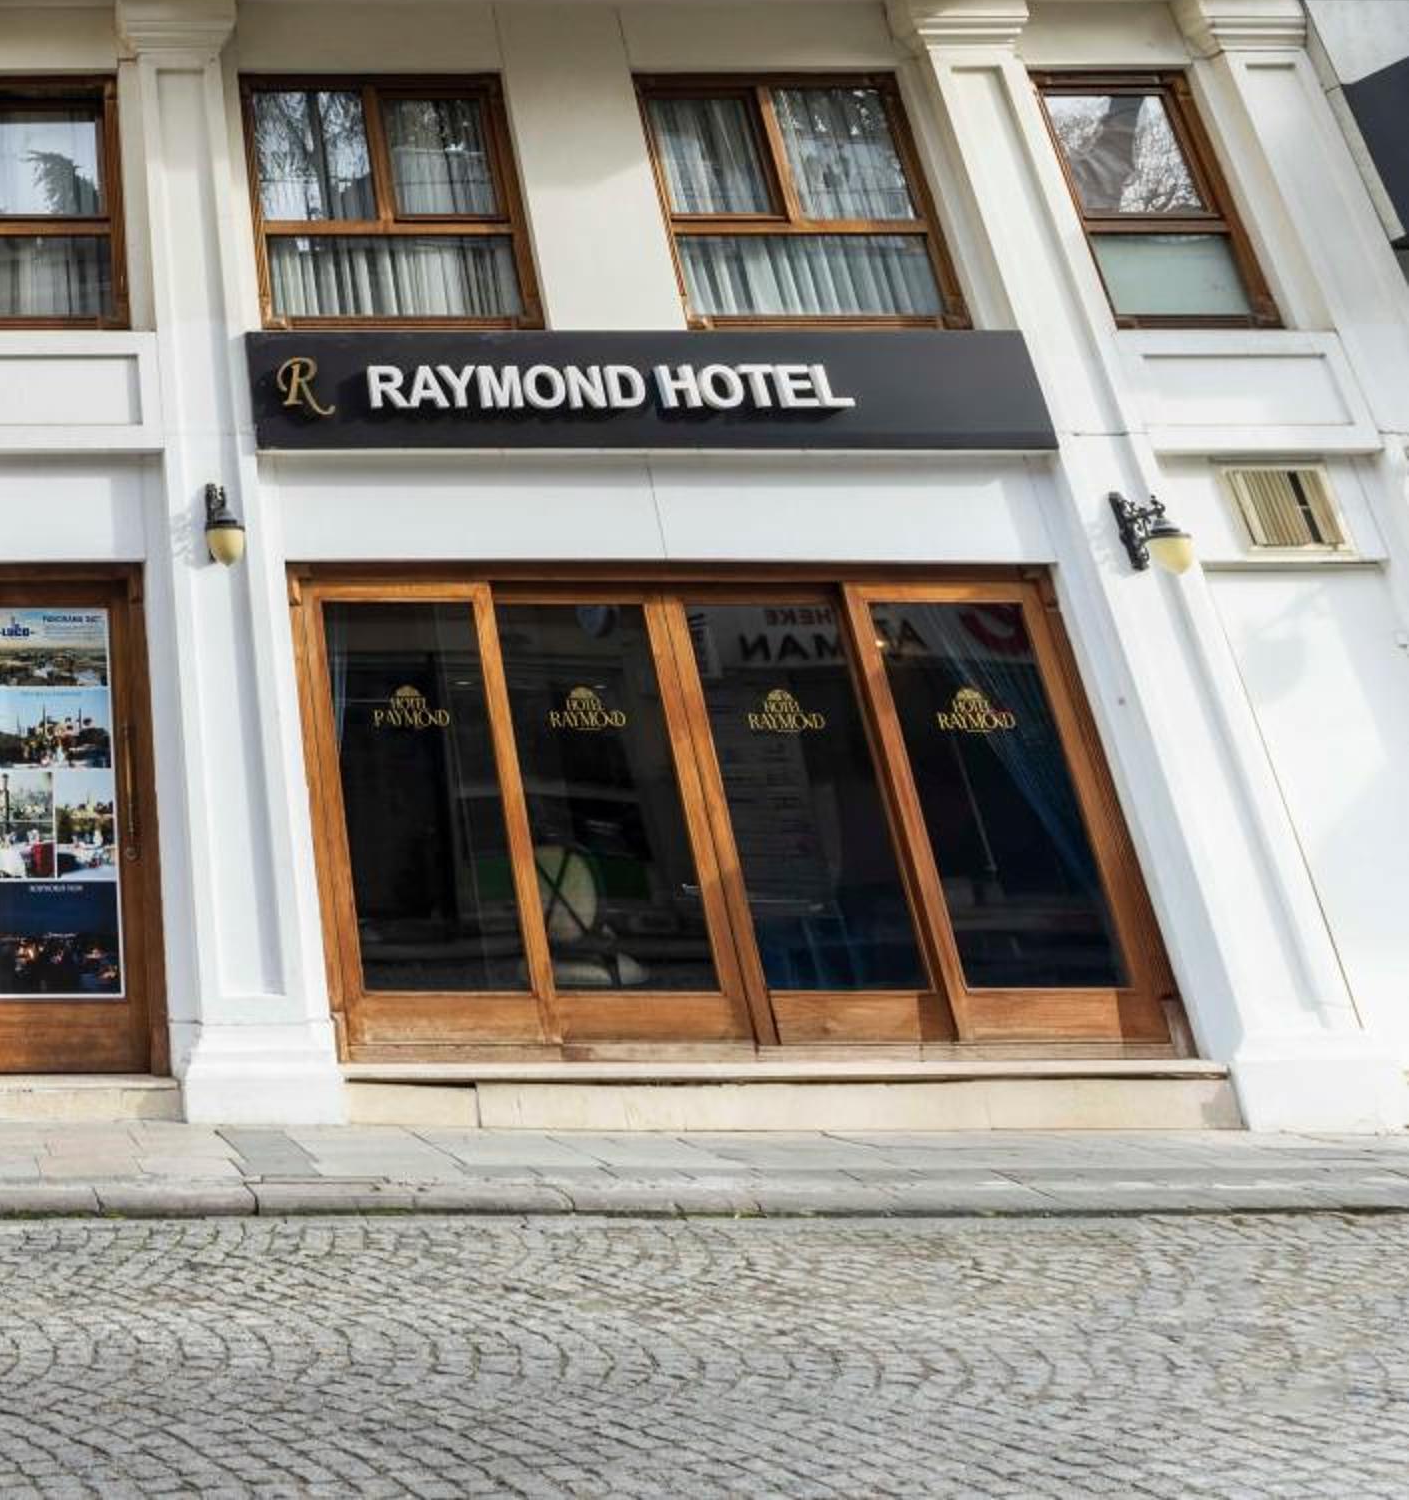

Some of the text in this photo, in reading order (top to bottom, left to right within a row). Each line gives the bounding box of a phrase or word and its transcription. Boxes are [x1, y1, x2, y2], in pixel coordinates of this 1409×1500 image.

[277, 357, 335, 415] R
[367, 363, 856, 410] RAYMOND HOTEL
[567, 698, 603, 712] HOTEL
[763, 700, 800, 713] HOTEL
[951, 700, 991, 714] HOTEL
[548, 710, 627, 728] RAYMOND
[747, 712, 826, 731] RAYMOND
[936, 712, 1016, 730] RAYMOND
